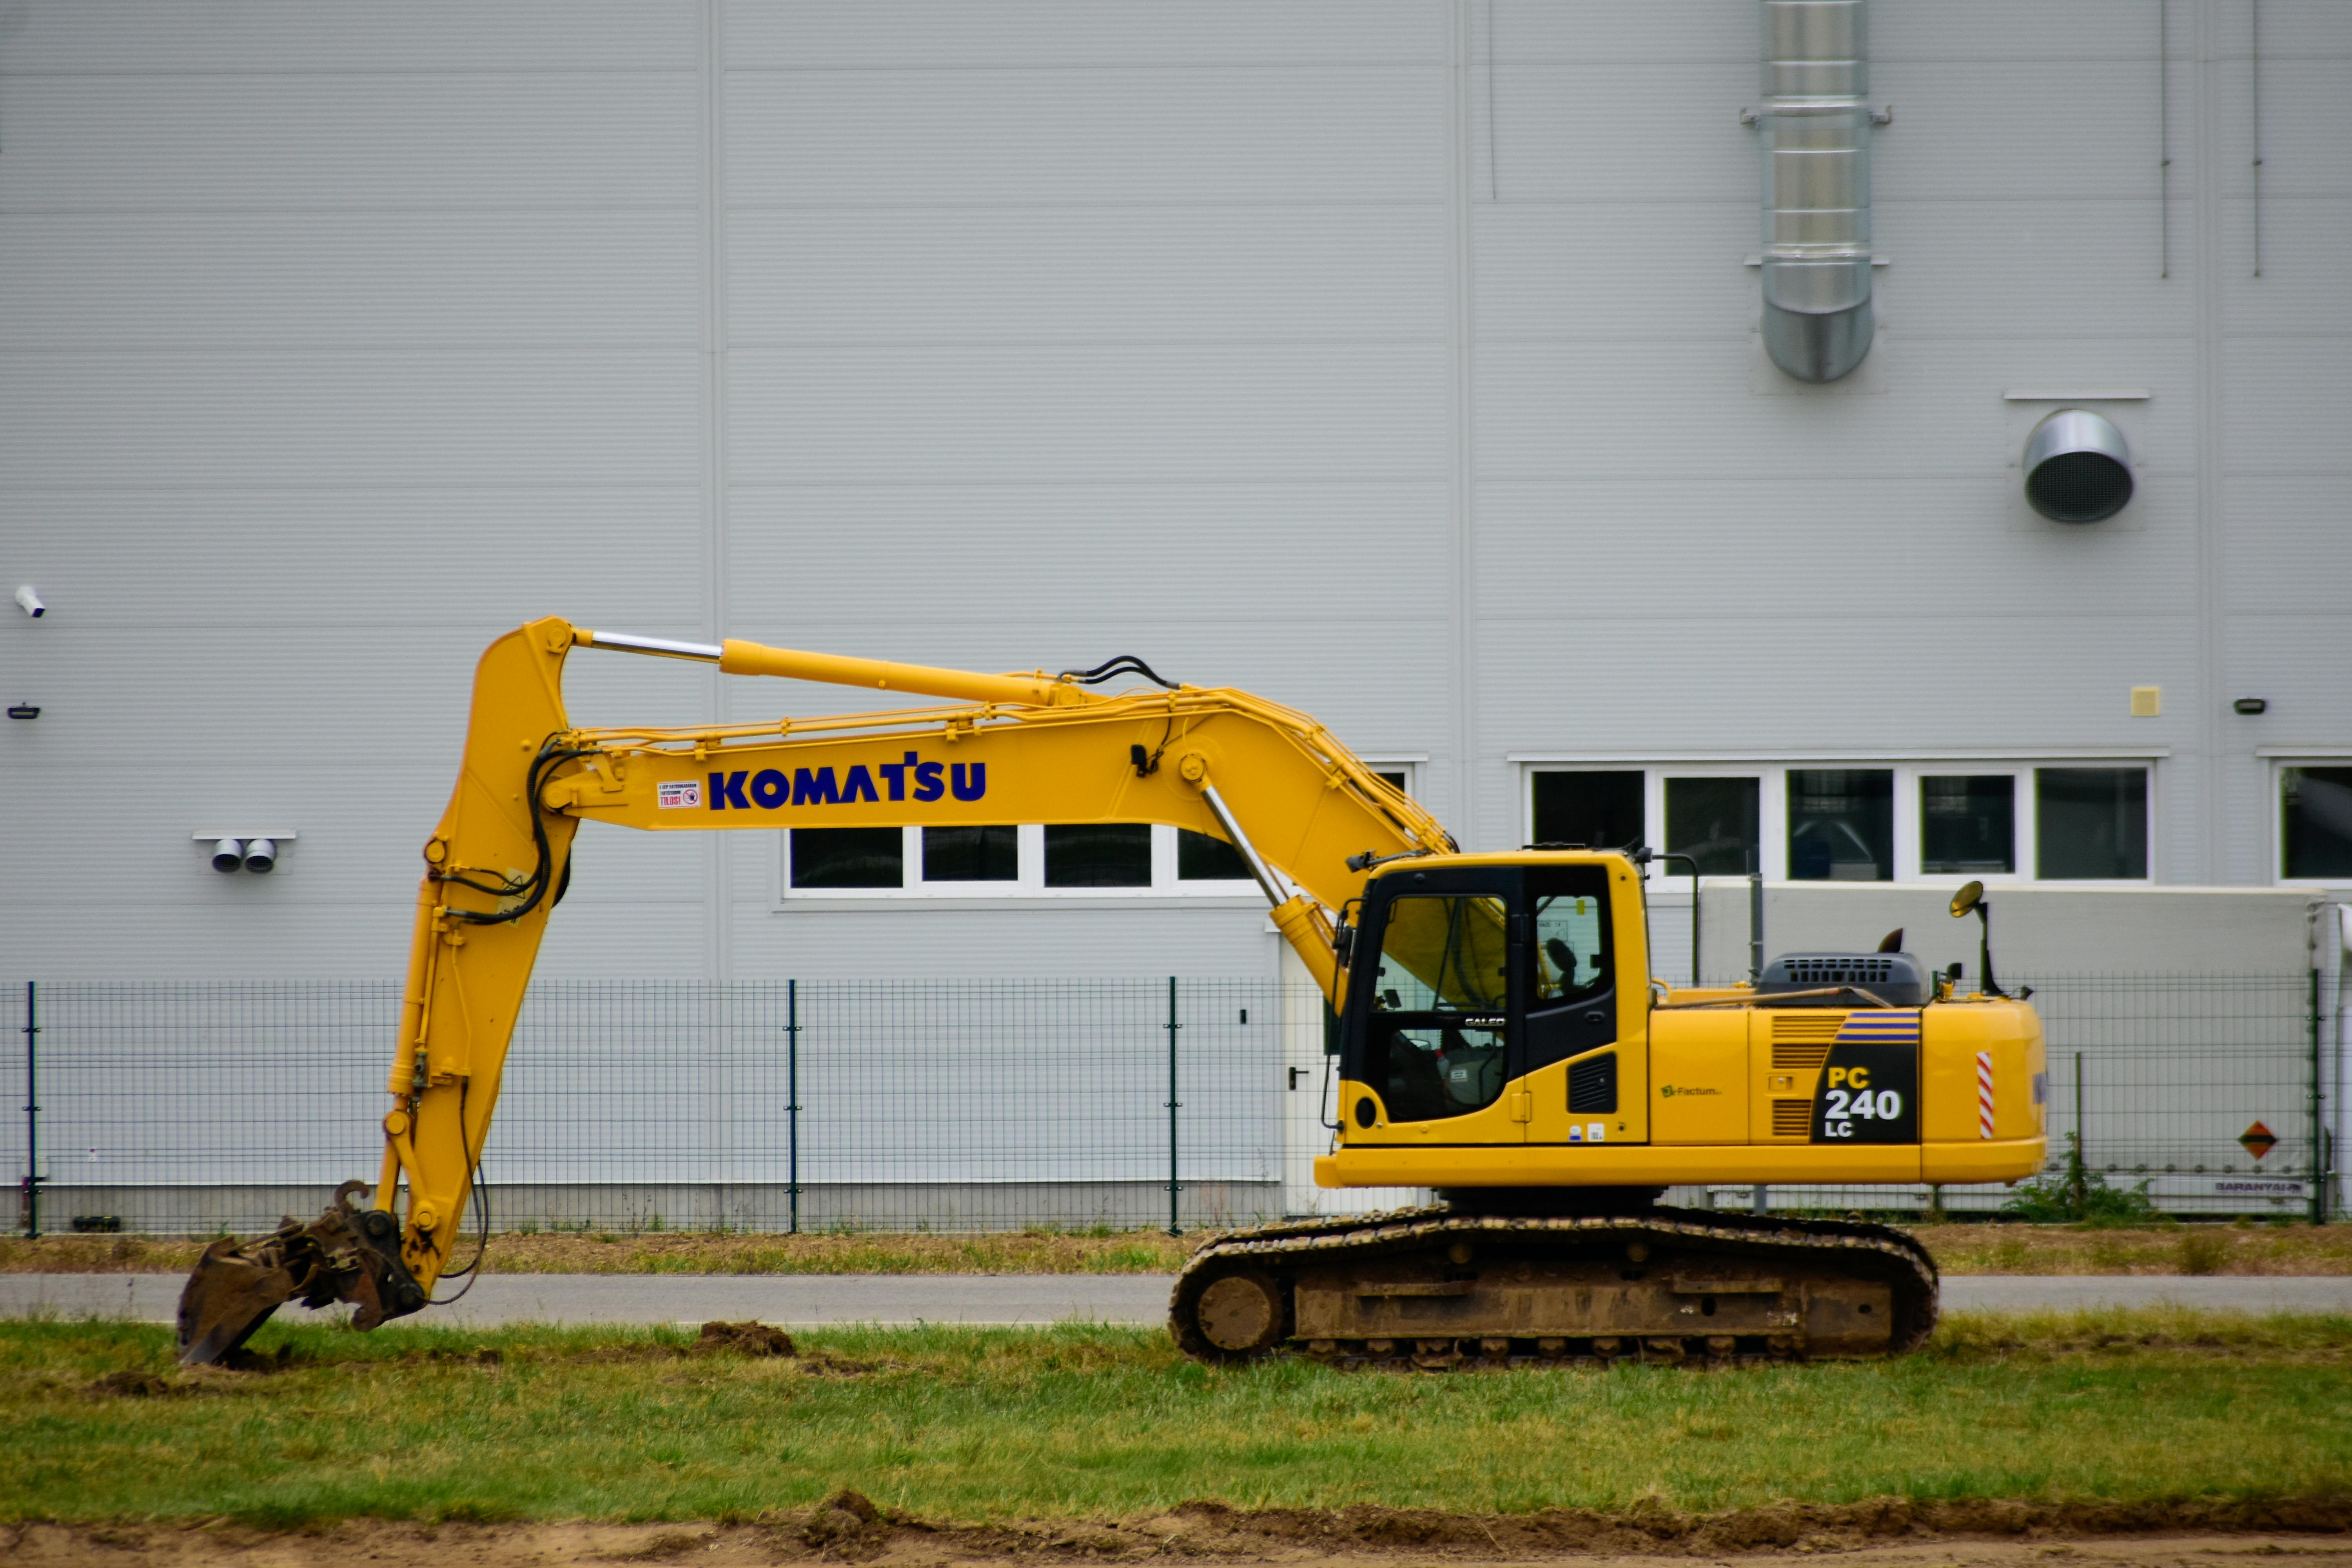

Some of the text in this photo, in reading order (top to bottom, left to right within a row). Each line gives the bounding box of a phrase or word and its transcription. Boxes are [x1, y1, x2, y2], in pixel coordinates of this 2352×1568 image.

[708, 751, 985, 810] KOMATSU
[660, 796, 681, 806] TILOS!
[1465, 1018, 1505, 1026] GALEO
[1828, 1066, 1869, 1089] PC
[1825, 1090, 1902, 1120] 240
[1825, 1122, 1853, 1137] LC
